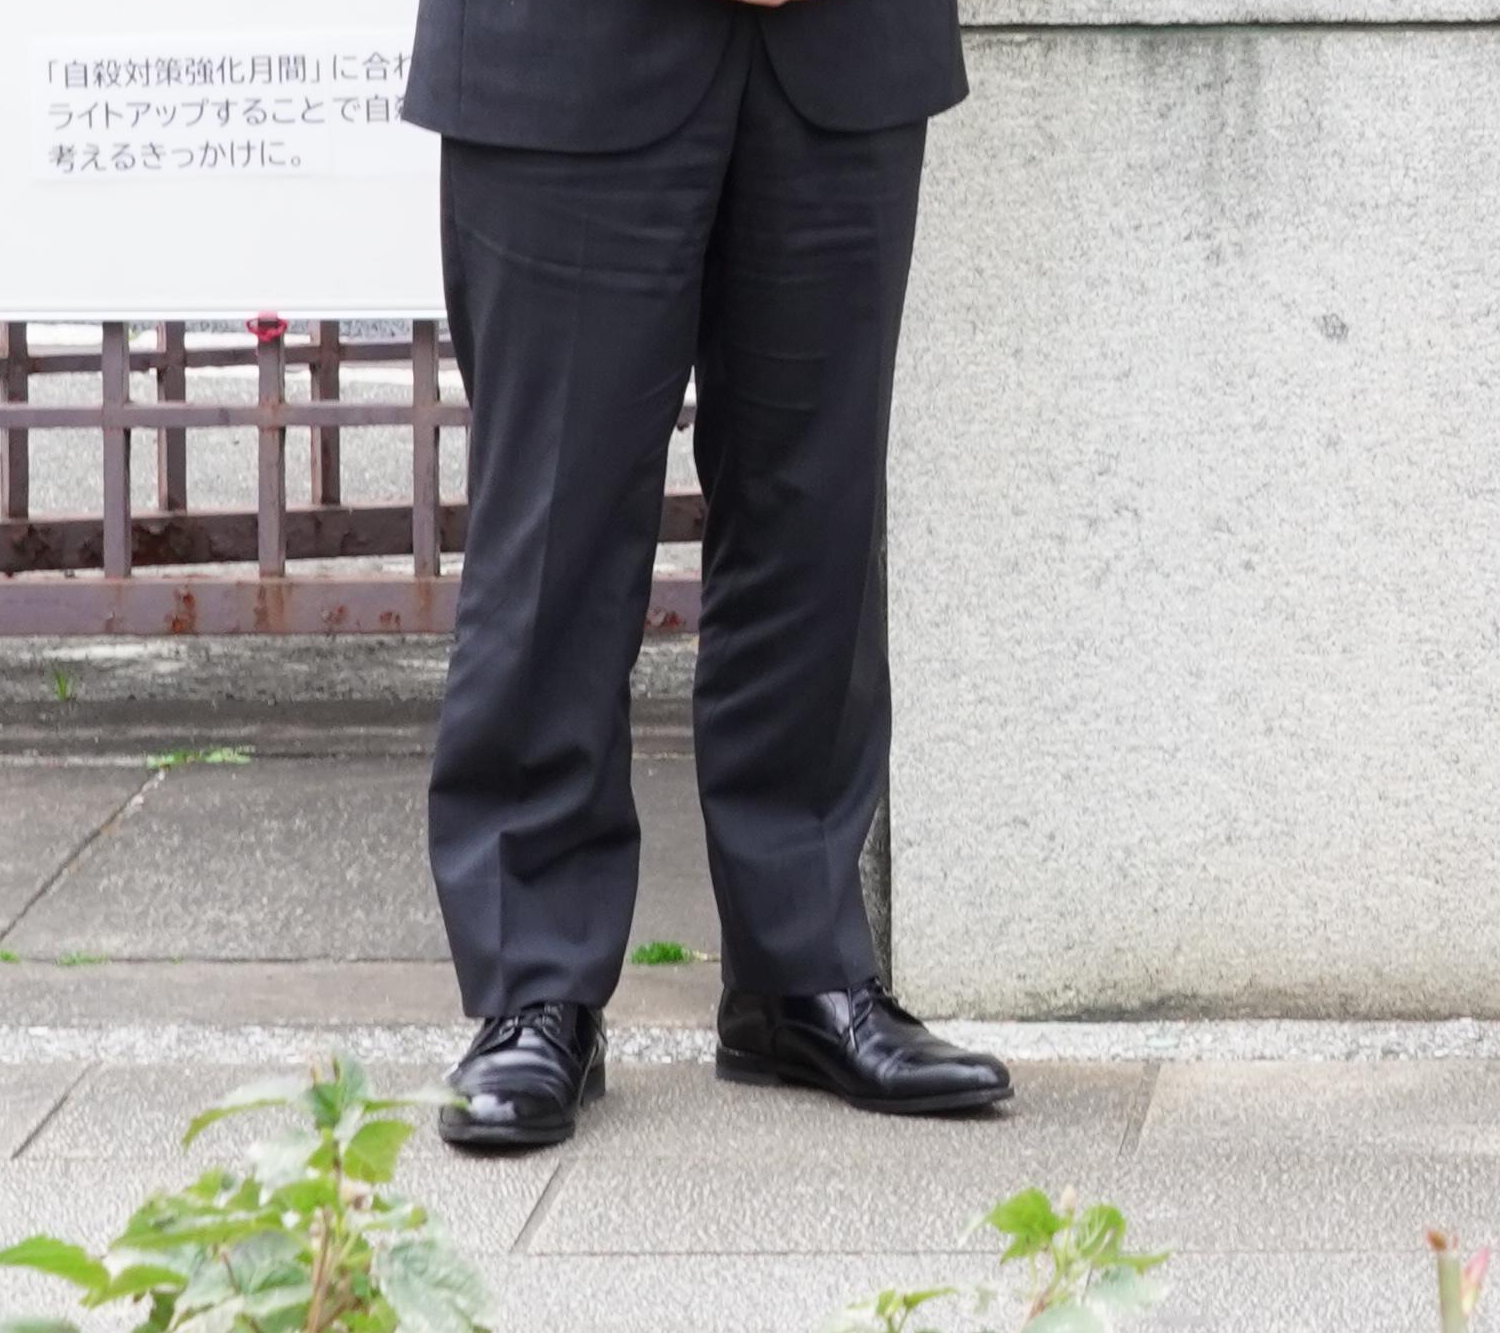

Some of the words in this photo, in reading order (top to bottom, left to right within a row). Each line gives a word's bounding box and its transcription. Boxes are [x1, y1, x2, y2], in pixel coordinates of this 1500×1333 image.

[47, 94, 406, 130] ライトアップすることで自
[49, 139, 303, 173] 考えるきっかけに。
